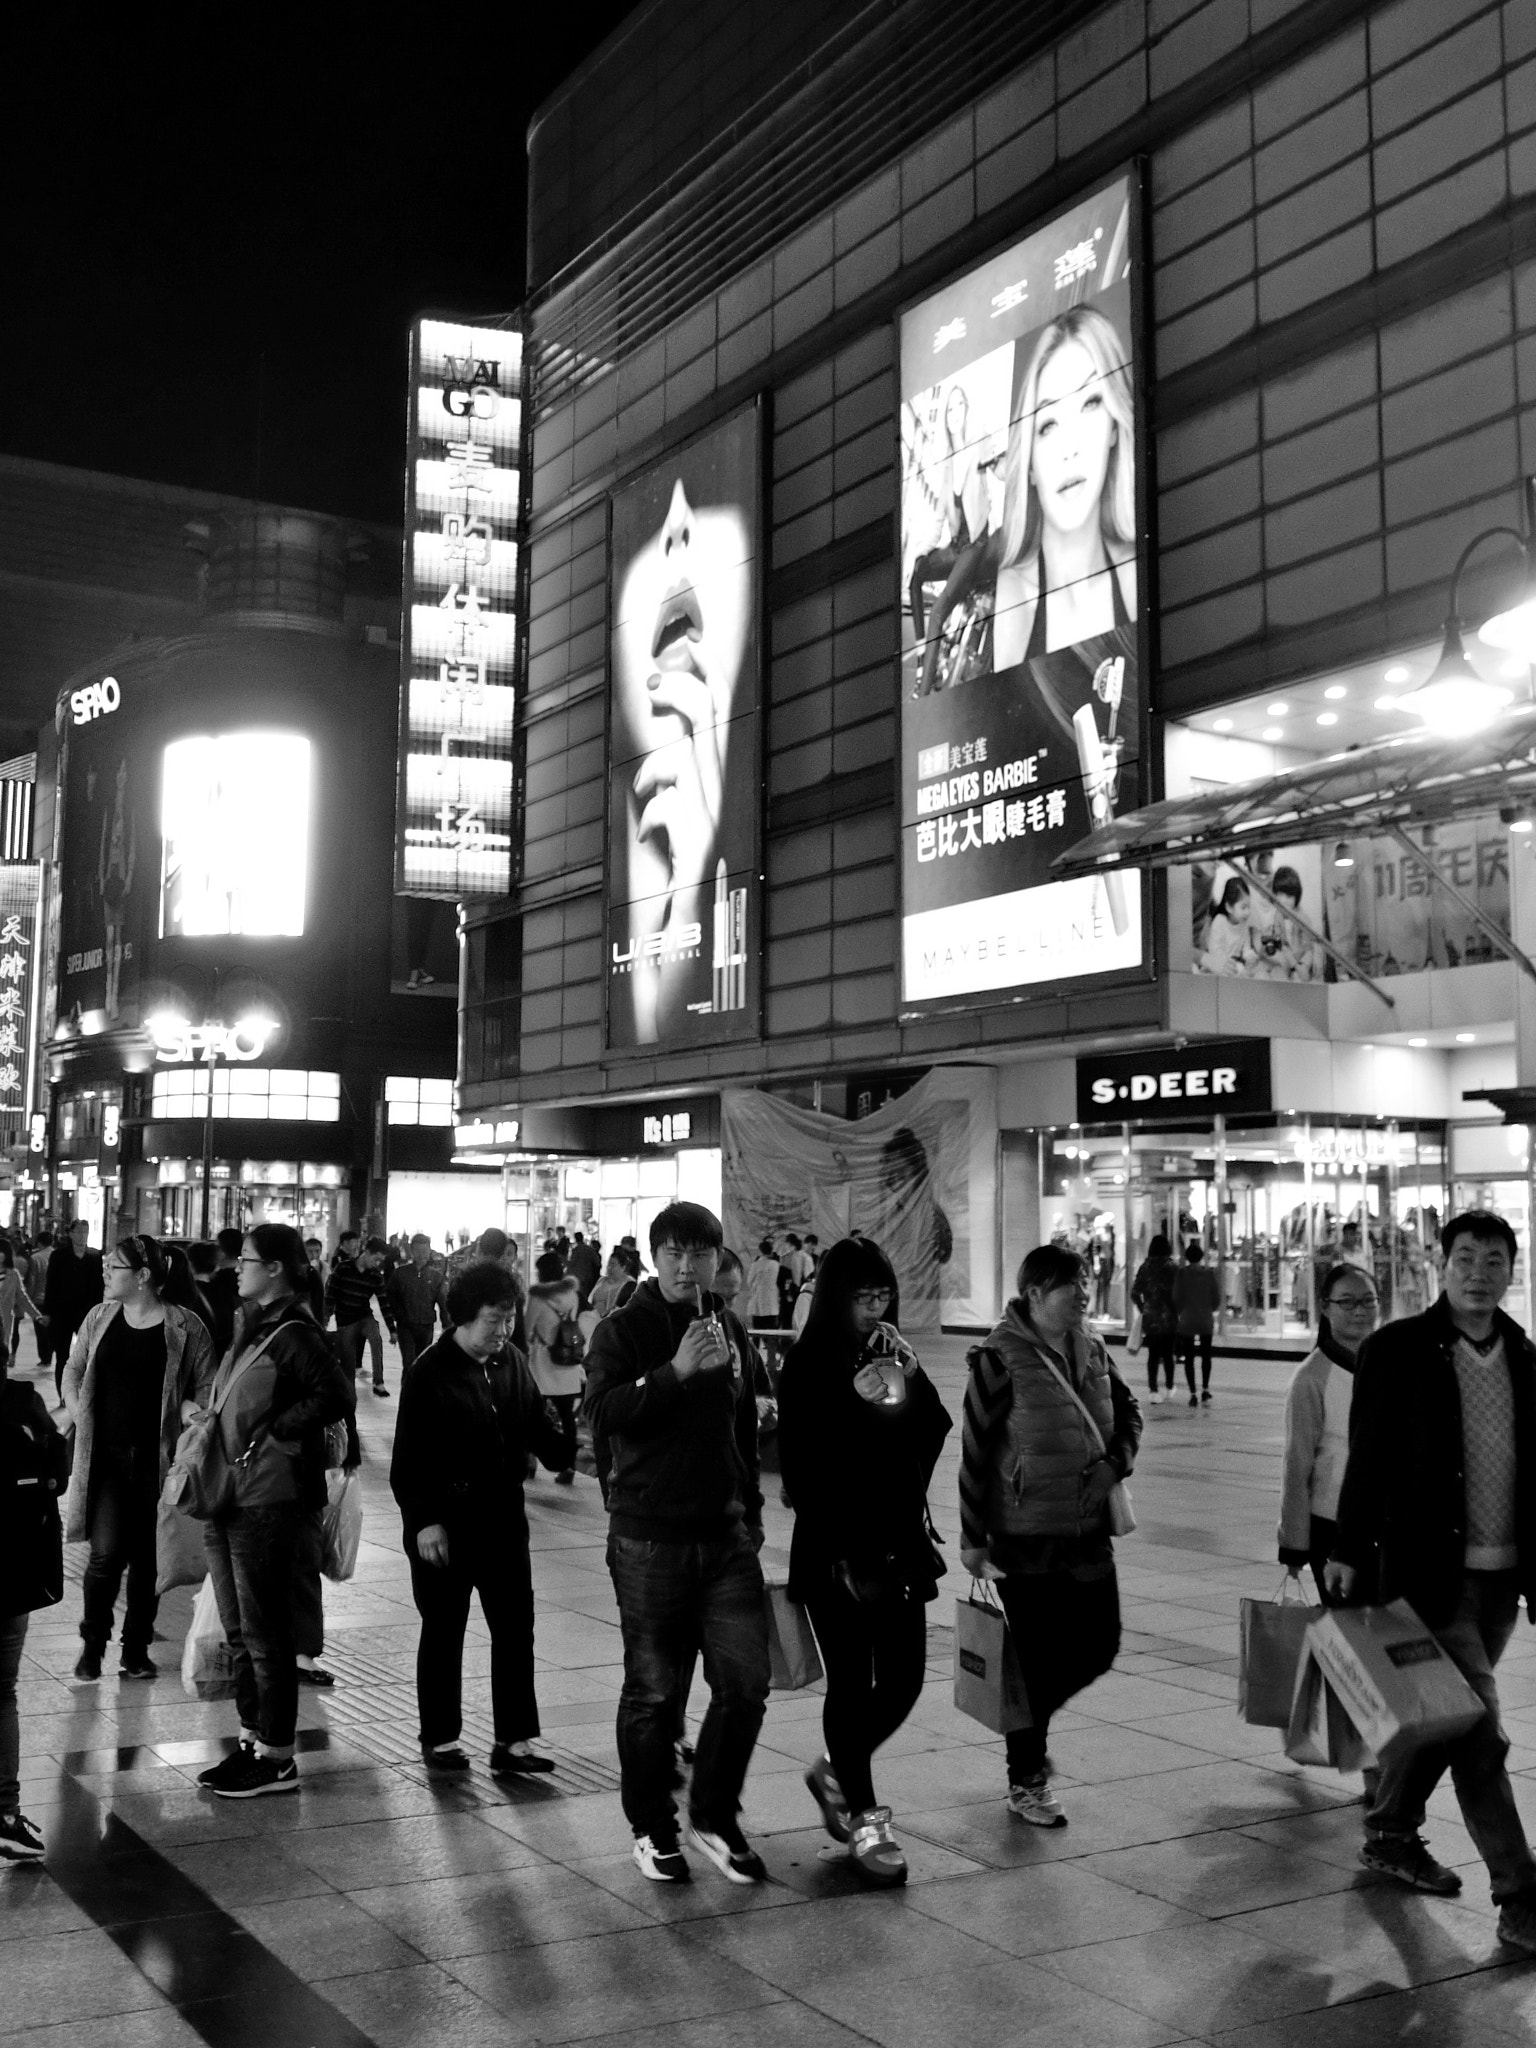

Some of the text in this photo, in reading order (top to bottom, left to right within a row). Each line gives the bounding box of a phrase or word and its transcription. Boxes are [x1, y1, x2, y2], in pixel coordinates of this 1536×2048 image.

[442, 385, 500, 419] GO
[70, 676, 121, 725] SPAO
[949, 736, 988, 771] 美宝莲
[916, 755, 1038, 816] MEGA EYES BARBIE
[915, 789, 1067, 863] 芭比大眼睫毛膏
[923, 916, 1104, 970] MAYBELLINE
